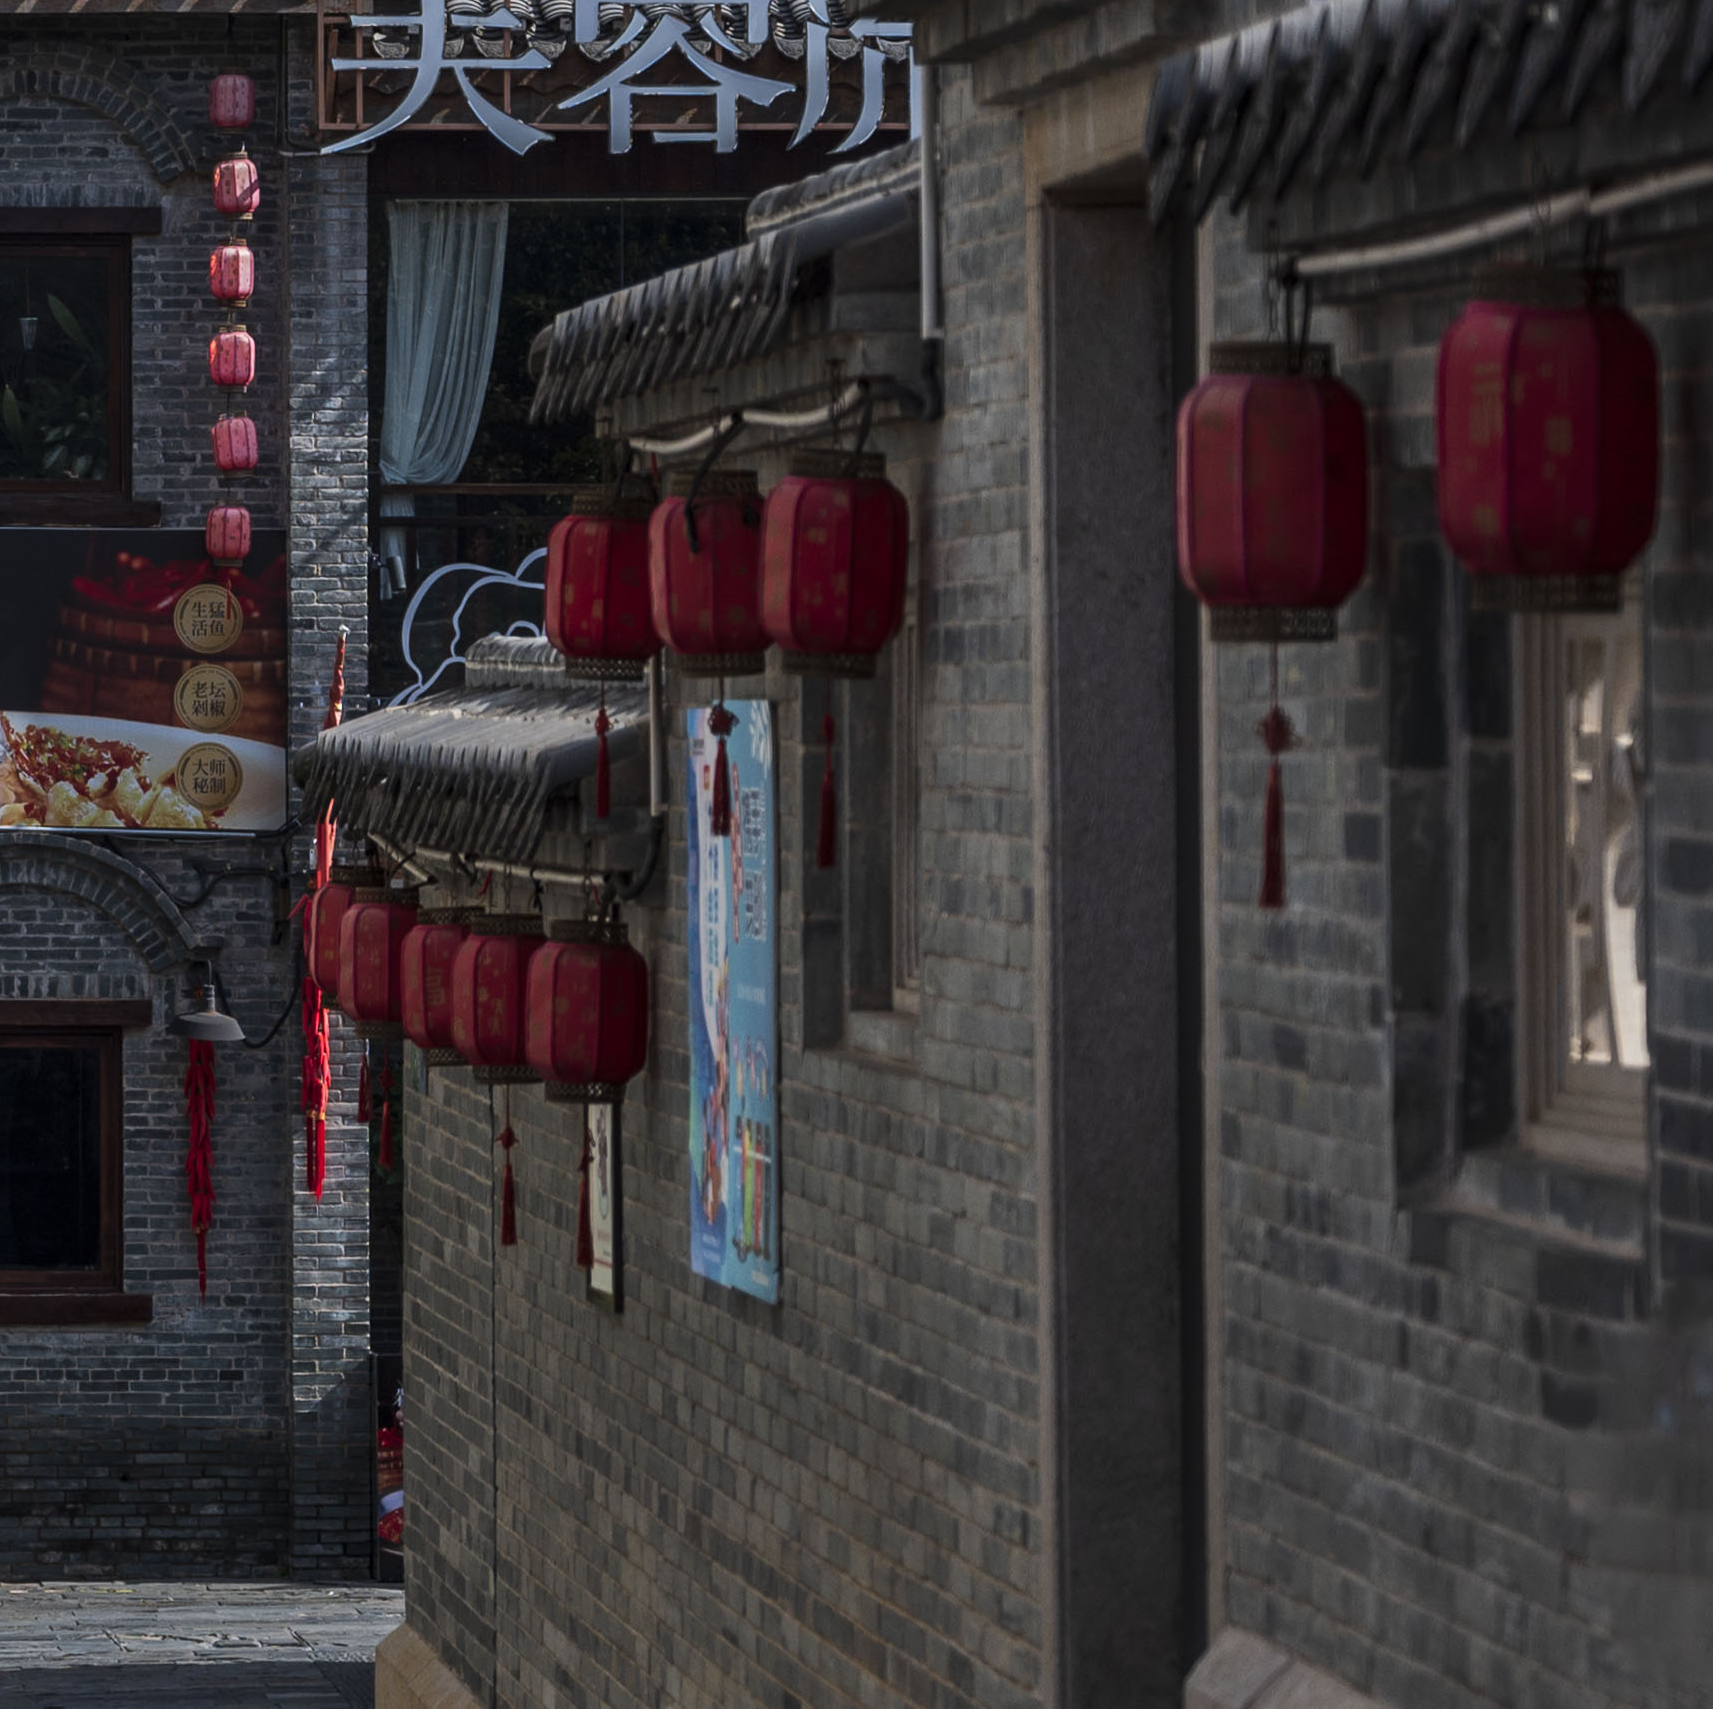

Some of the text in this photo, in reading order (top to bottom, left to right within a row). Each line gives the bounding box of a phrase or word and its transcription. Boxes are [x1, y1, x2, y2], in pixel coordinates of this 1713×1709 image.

[191, 620, 225, 637] 活鱼
[192, 681, 226, 699] 老坛
[192, 699, 225, 717] 剁椒
[192, 758, 226, 777] 大师
[193, 777, 226, 795] 秘制
